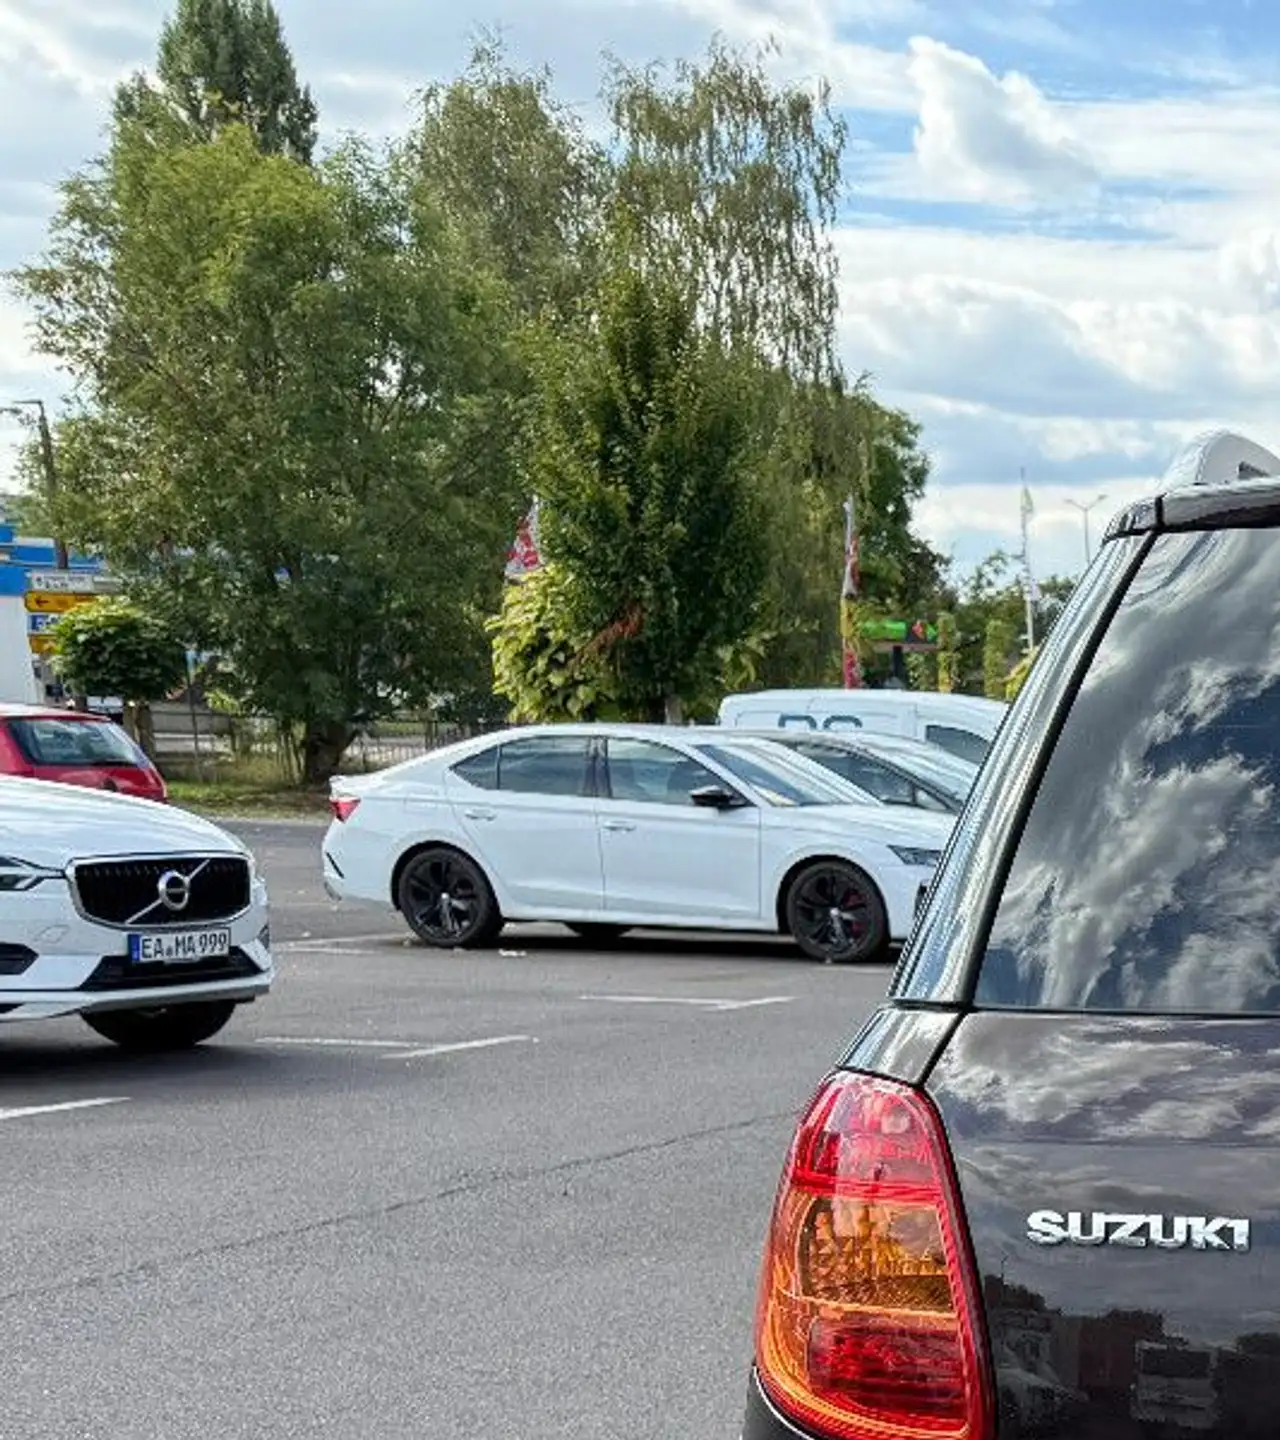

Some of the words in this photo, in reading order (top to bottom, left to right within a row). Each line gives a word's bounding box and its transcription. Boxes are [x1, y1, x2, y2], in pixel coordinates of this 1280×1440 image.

[142, 938, 164, 958] EA
[200, 932, 228, 953] 999
[1027, 1209, 1249, 1251] SUZUKI
